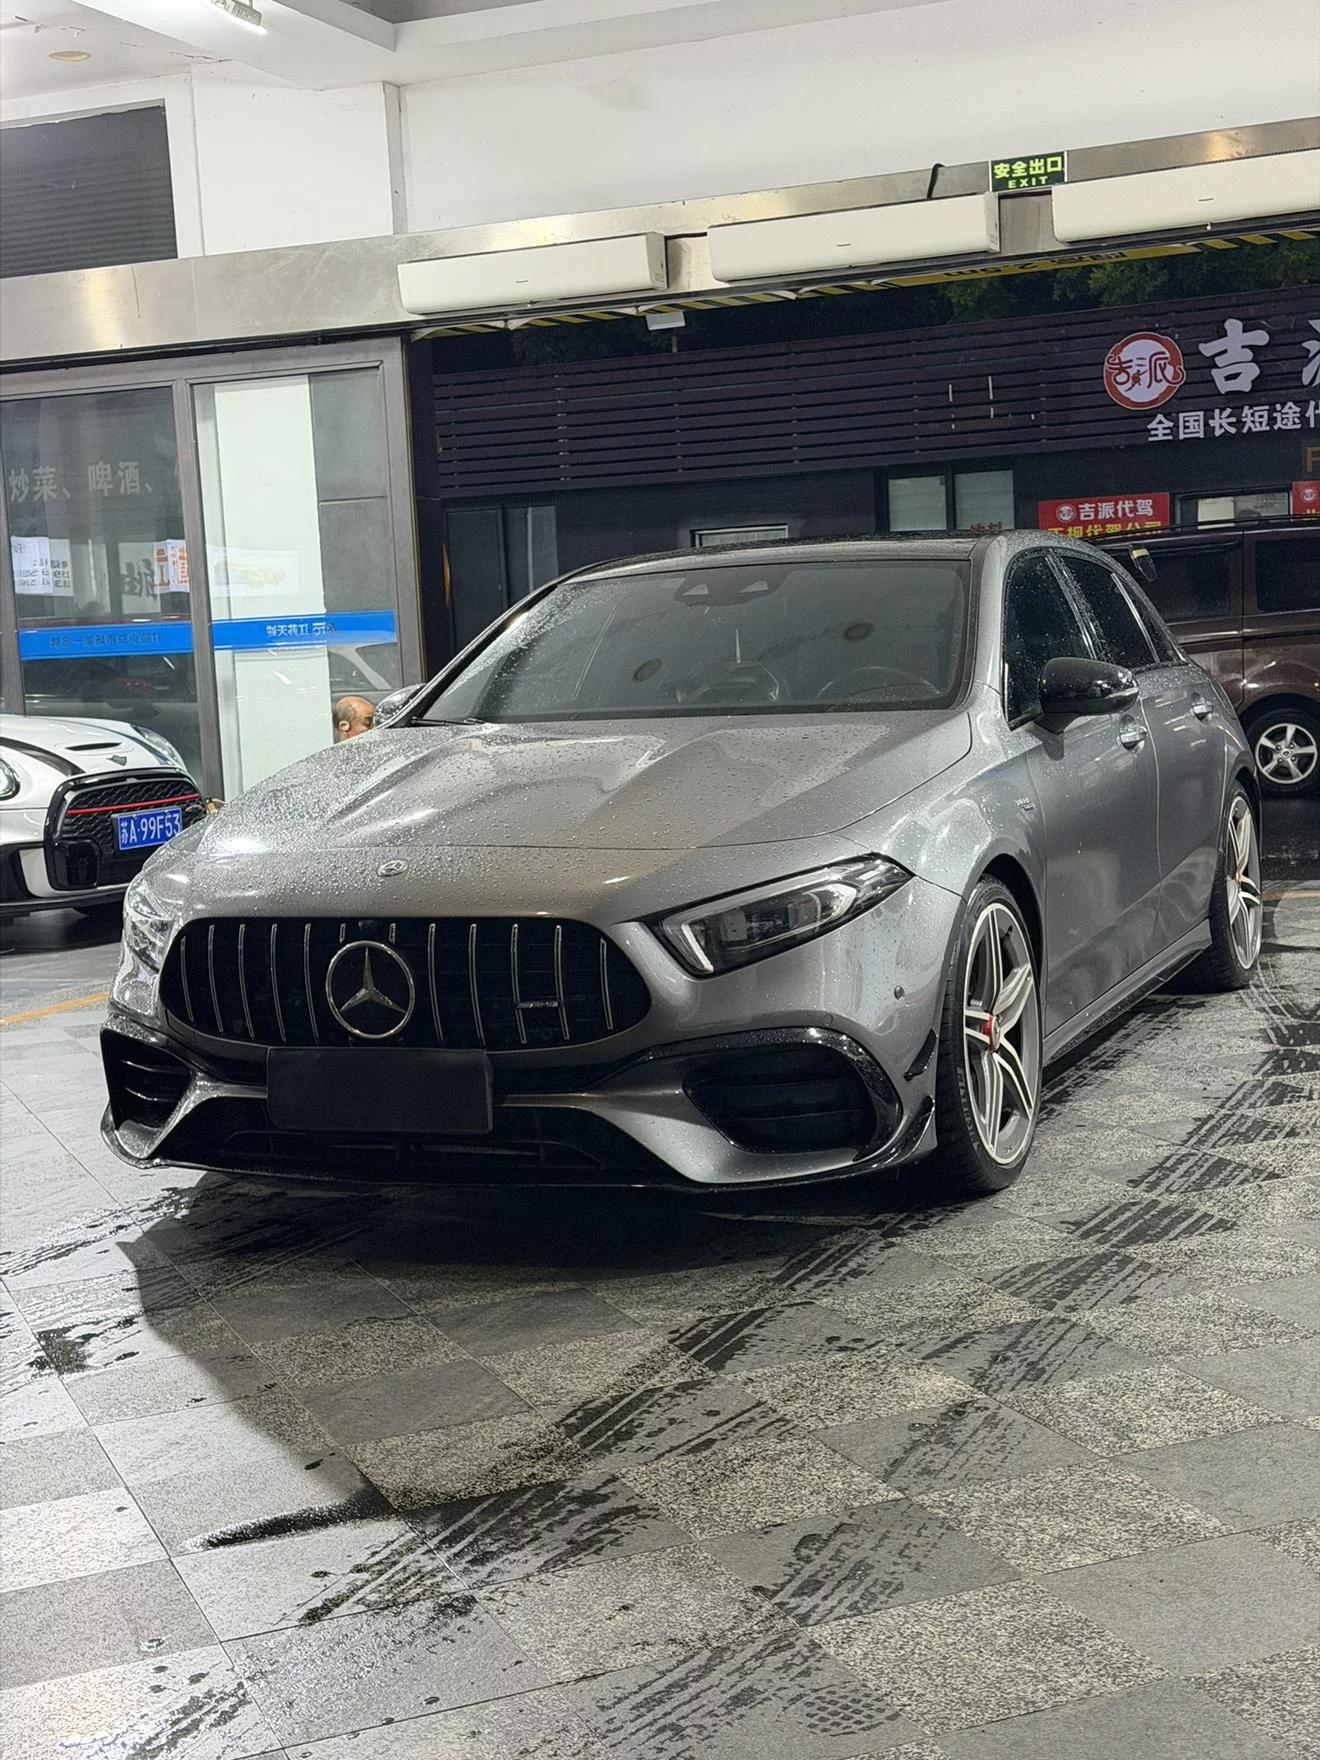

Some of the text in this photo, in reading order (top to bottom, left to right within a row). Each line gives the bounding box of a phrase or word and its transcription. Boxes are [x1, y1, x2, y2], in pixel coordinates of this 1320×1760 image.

[993, 156, 1062, 179] 安全出口
[1007, 175, 1048, 189] EXIT
[1198, 318, 1320, 395] 吉
[1078, 499, 1153, 520] 吉派代驾
